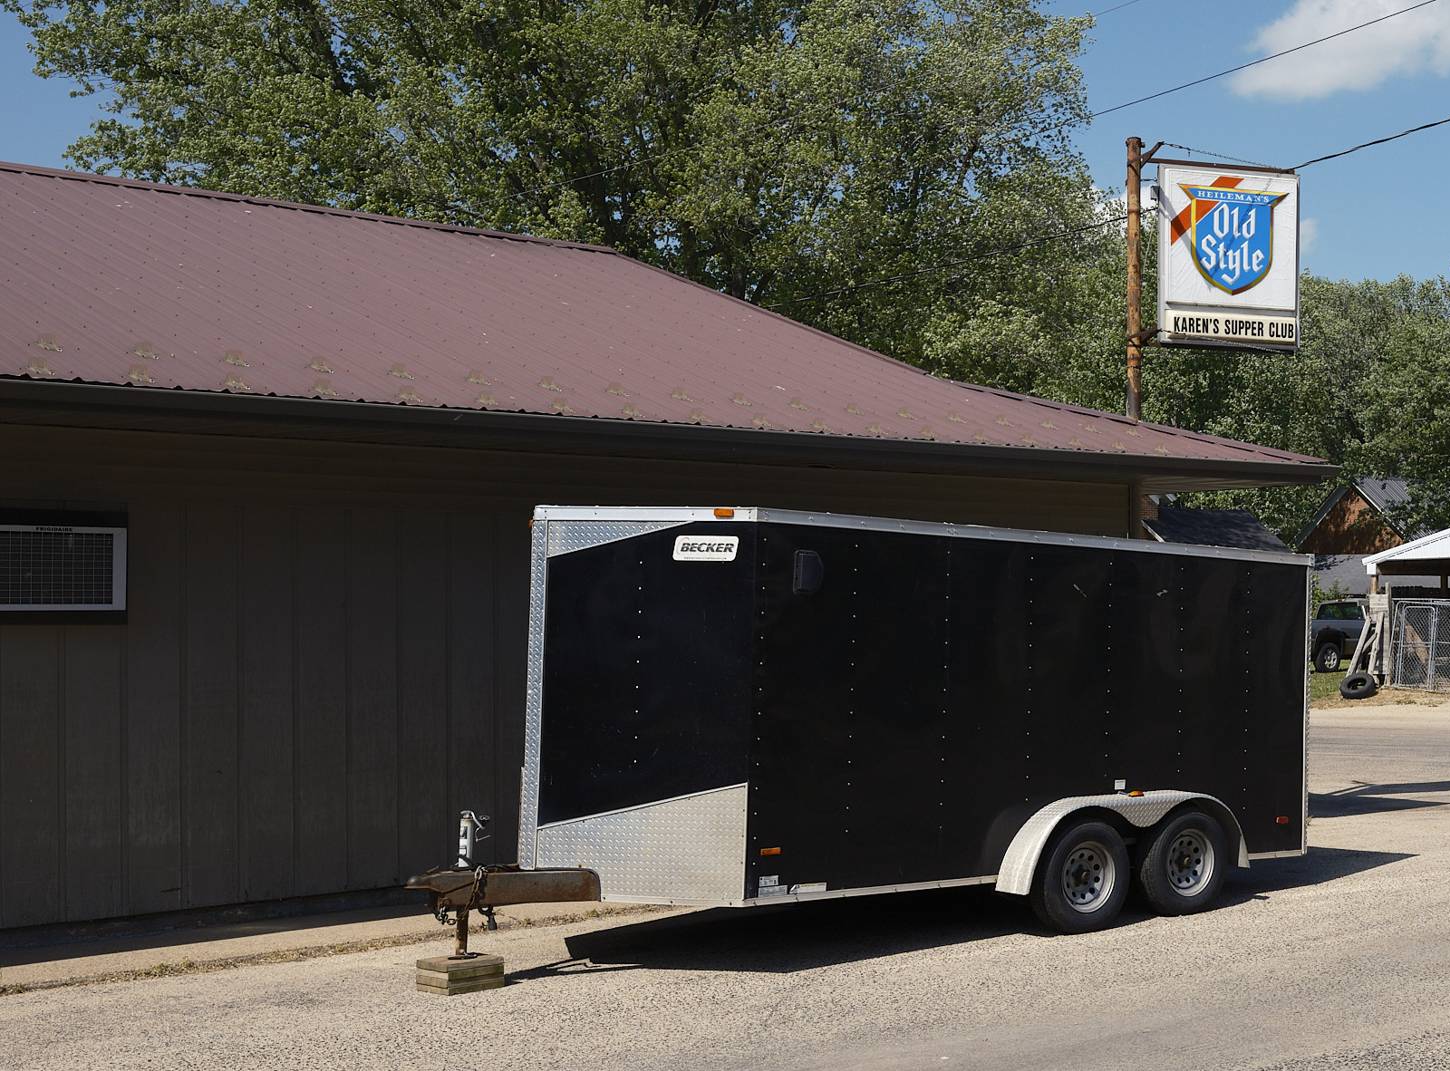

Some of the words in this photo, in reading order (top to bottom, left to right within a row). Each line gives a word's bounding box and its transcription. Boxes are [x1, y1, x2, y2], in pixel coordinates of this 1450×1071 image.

[1197, 190, 1270, 203] HEILEMAN'S
[1213, 203, 1257, 239] Old
[1200, 234, 1265, 286] Style
[1173, 316, 1220, 334] KAREN'S
[1224, 319, 1264, 337] SUPPER
[1268, 322, 1294, 339] CLUB
[680, 542, 735, 553] BECKER
